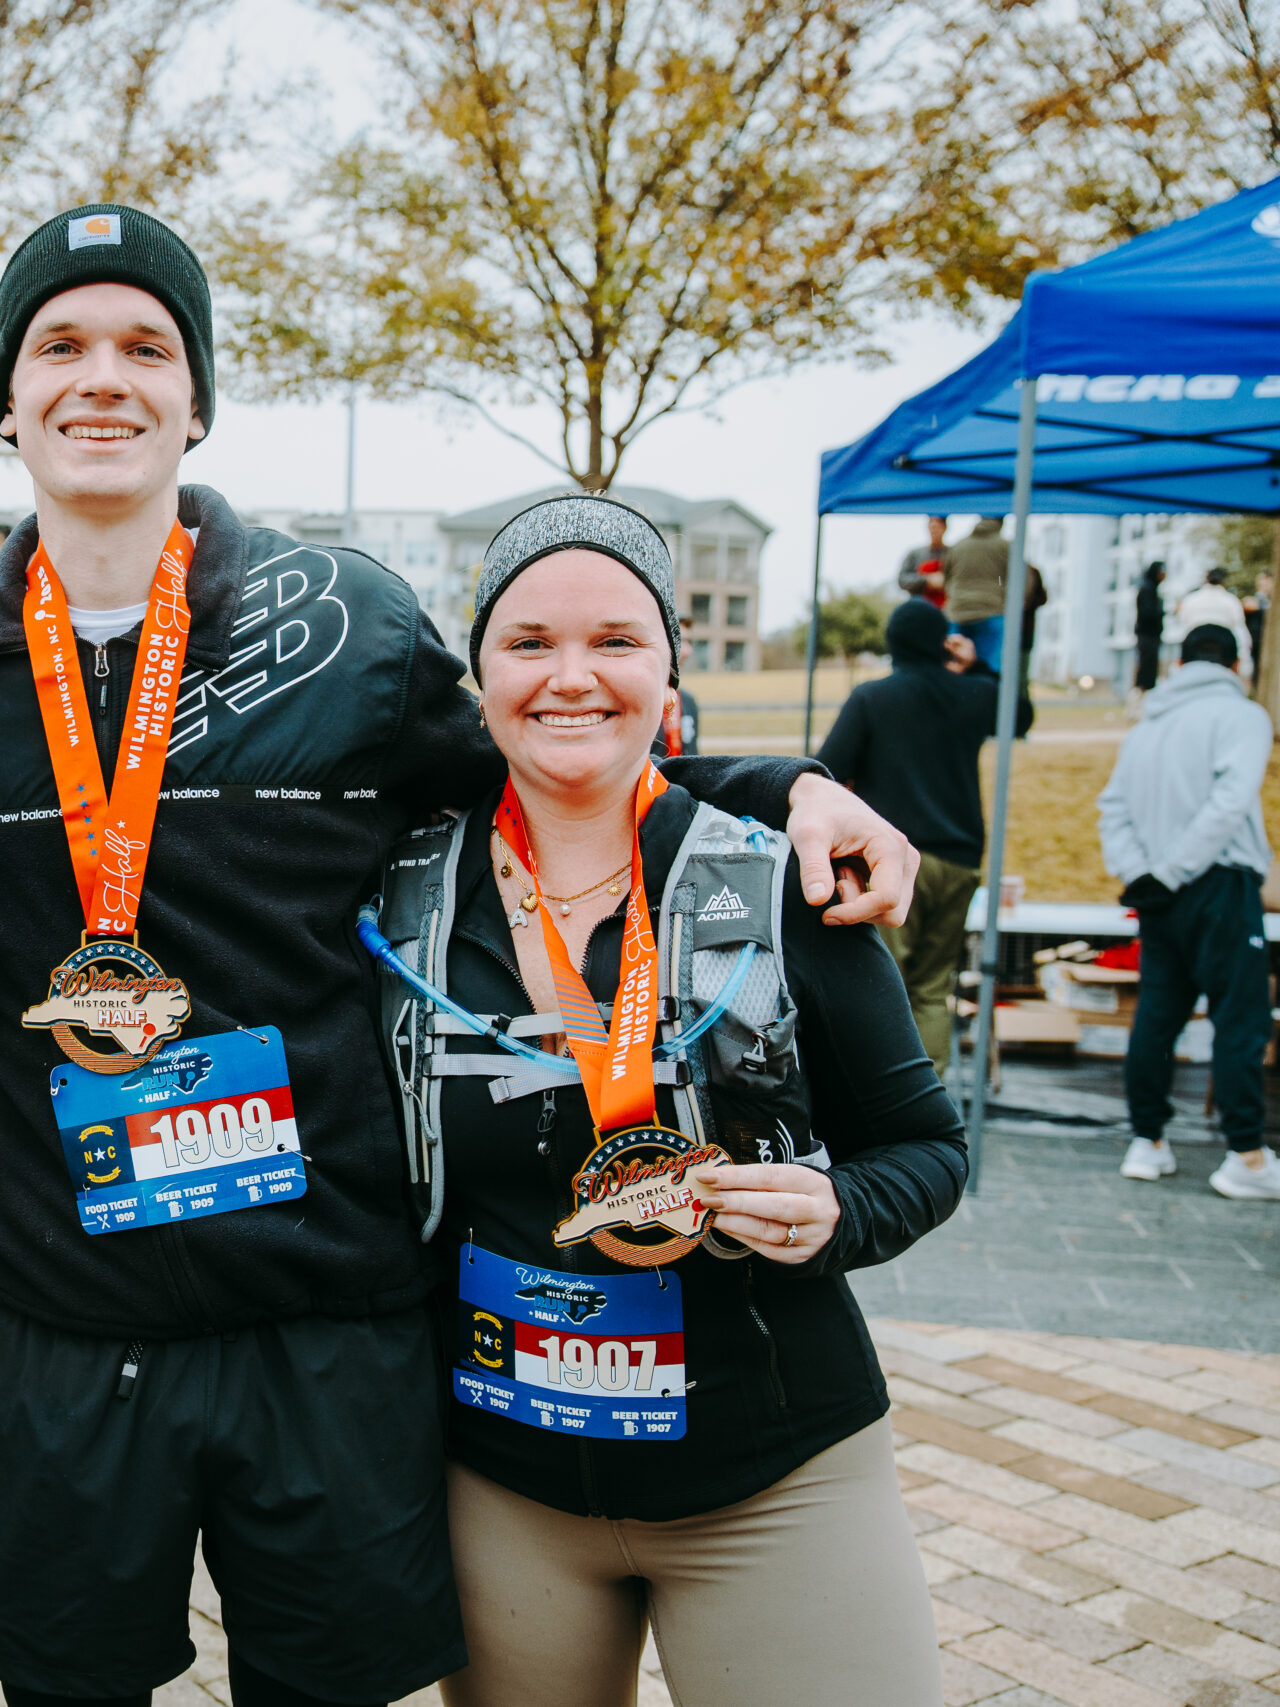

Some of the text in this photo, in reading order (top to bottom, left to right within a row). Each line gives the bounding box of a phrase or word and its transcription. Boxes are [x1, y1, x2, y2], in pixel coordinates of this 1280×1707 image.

[37, 566, 52, 604] 2025
[156, 549, 191, 634] Half
[47, 625, 79, 747] WILMINGTON, NC
[148, 636, 179, 736] HISTORIC
[126, 633, 164, 770] WILMINGTON
[158, 788, 219, 800] ew balance
[255, 788, 321, 800] new balance
[344, 790, 360, 799] new
[21, 808, 63, 821] balance
[103, 828, 145, 917] Half
[399, 859, 417, 867] WIND
[51, 966, 181, 1003] Wilmington
[73, 1000, 127, 1008] HISTORIC
[632, 958, 652, 1044] HISTORIC
[98, 1010, 147, 1027] HALF
[612, 968, 638, 1080] WILMINGTON
[152, 1046, 200, 1065] mington
[153, 1061, 196, 1074] HISTORIC
[141, 1071, 181, 1092] RUN
[144, 1092, 171, 1103] HALF
[150, 1097, 275, 1168] 1909
[84, 1145, 116, 1164] N C
[236, 1167, 297, 1188] BEER TICKET
[575, 1146, 719, 1202] Wilmington
[156, 1183, 218, 1203] BEER TICKET
[269, 1182, 293, 1194] 1909
[607, 1185, 668, 1209] HISTORIC
[85, 1198, 138, 1215] FOOD TICKET
[190, 1198, 214, 1209] 1909
[637, 1188, 694, 1220] HALF
[115, 1212, 135, 1223] 1909
[515, 1266, 596, 1293] Wilmington
[534, 1294, 571, 1313] RUN
[546, 1290, 589, 1303] HISTORIC
[534, 1310, 560, 1323] HALF
[474, 1330, 502, 1351] N C
[538, 1335, 657, 1391] 1907
[459, 1376, 515, 1400] FOOD TICKET
[489, 1397, 510, 1411] 1907
[530, 1399, 592, 1418] BEER TICKET
[561, 1417, 586, 1429] 1907
[612, 1411, 678, 1421] BEER TICKET
[646, 1423, 671, 1434] 1907
